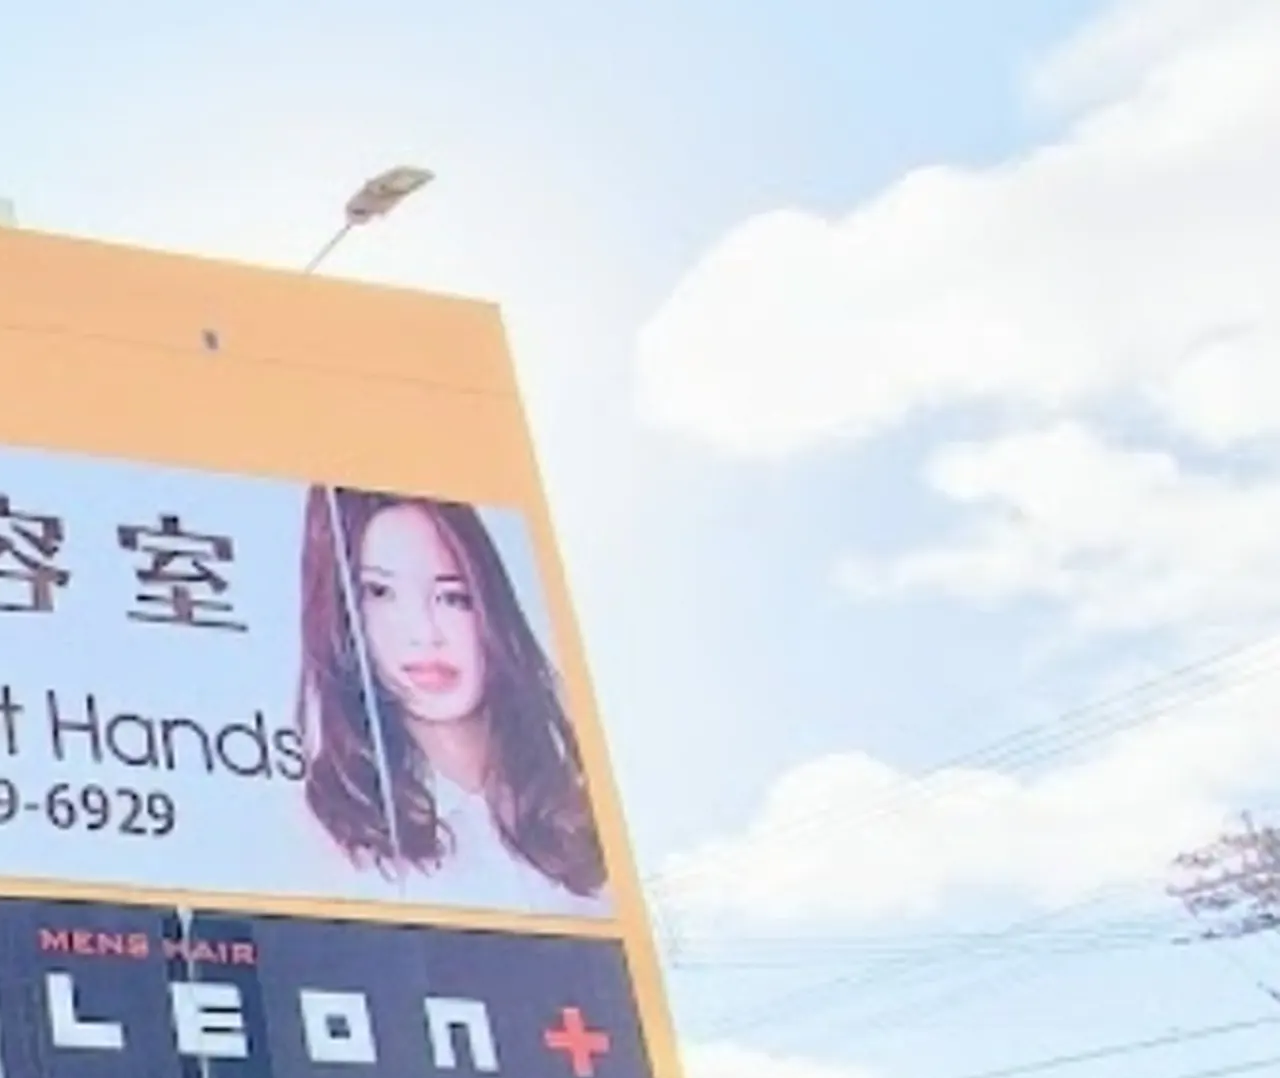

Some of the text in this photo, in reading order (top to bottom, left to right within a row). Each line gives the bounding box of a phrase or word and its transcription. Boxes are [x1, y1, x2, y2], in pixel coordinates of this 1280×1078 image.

[46, 690, 308, 783] Hands
[40, 928, 258, 965] MENS HAIR
